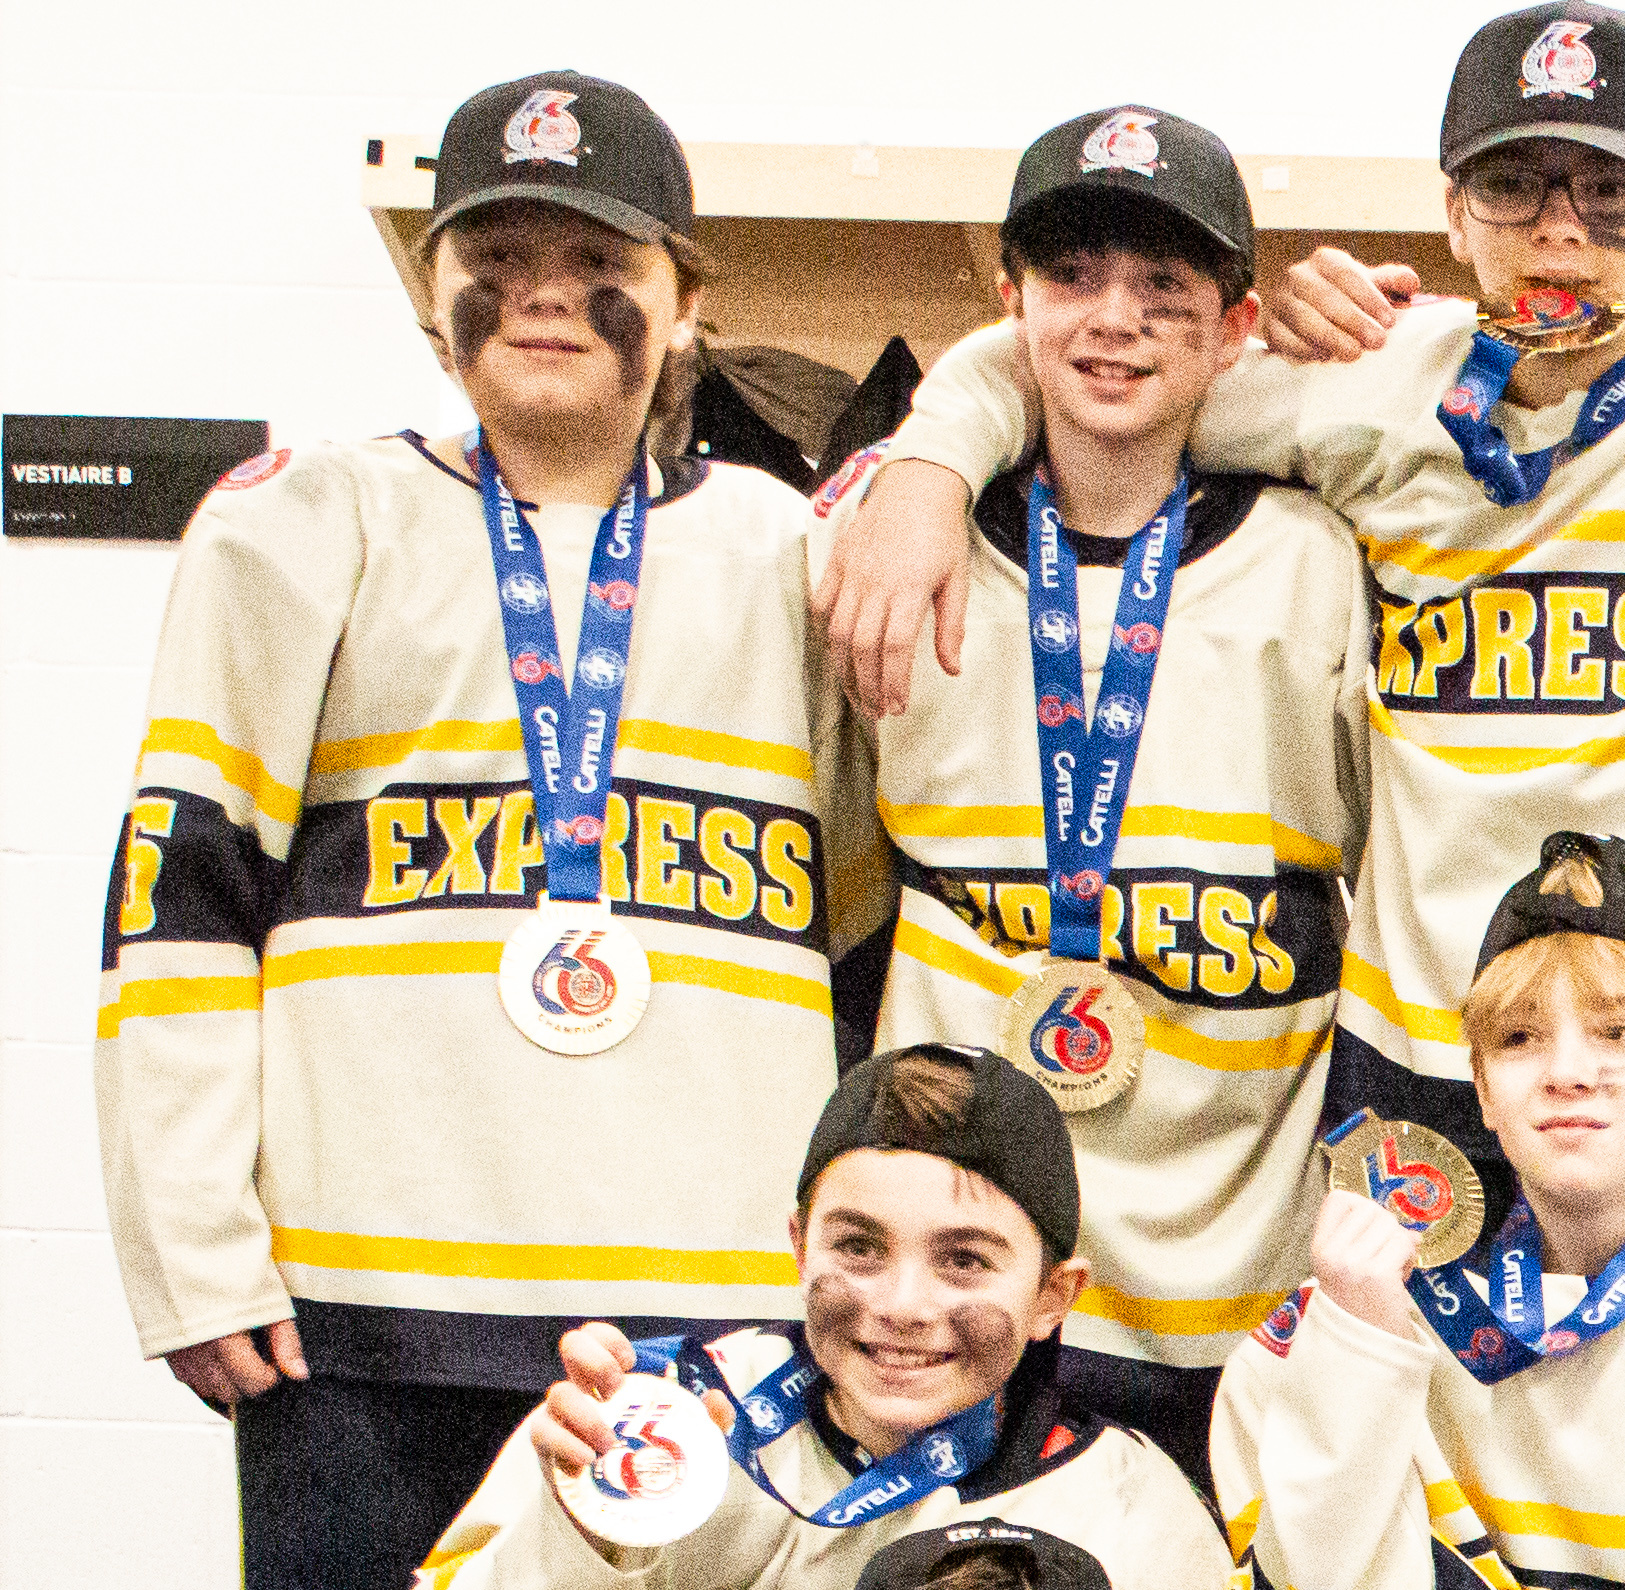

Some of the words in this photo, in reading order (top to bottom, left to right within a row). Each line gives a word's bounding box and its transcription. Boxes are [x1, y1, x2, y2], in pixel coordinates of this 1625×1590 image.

[12, 464, 114, 485] VESTIAIRE
[118, 466, 133, 486] B
[363, 795, 815, 934] EXPRESS
[827, 1474, 913, 1527] CATELLI
